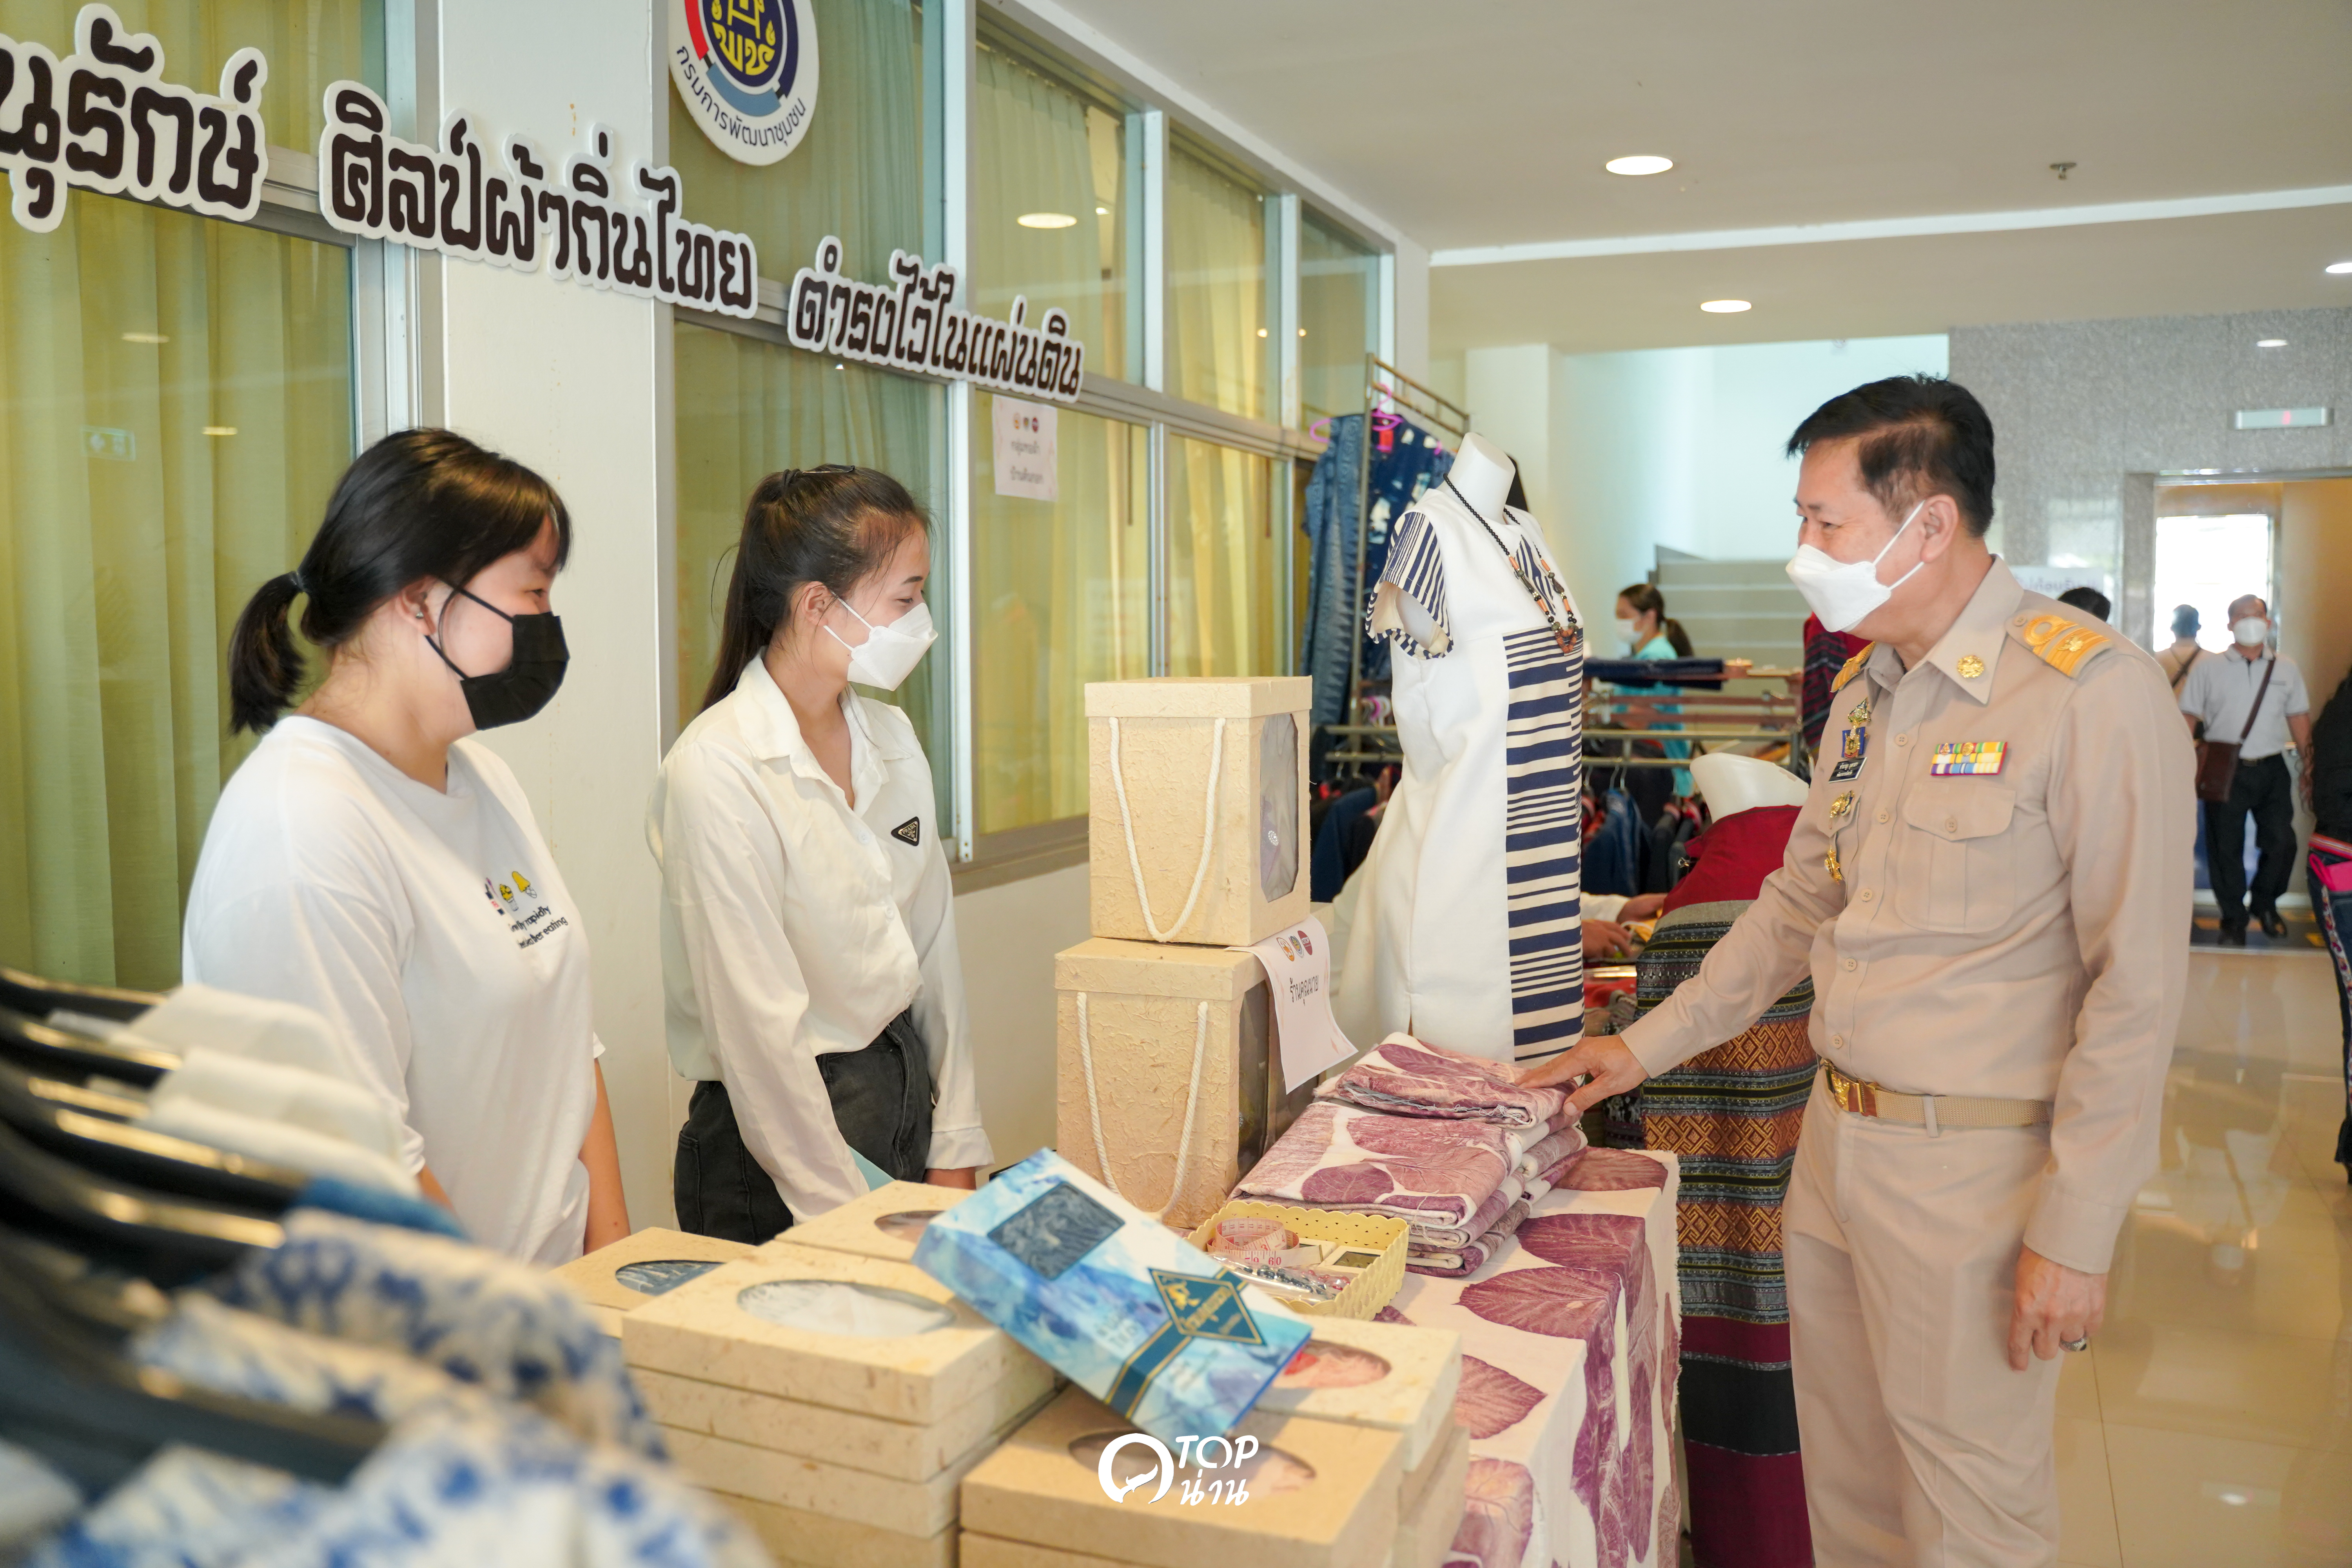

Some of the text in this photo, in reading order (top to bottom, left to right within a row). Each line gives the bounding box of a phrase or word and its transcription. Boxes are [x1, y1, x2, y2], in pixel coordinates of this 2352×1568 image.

[676, 45, 806, 147] กรมการพัฒนาชุมชน
[902, 824, 916, 834] PRADA
[543, 916, 569, 935] eating
[1290, 975, 1319, 1006] ร้านคุณนาย
[1269, 1257, 1281, 1265] 60
